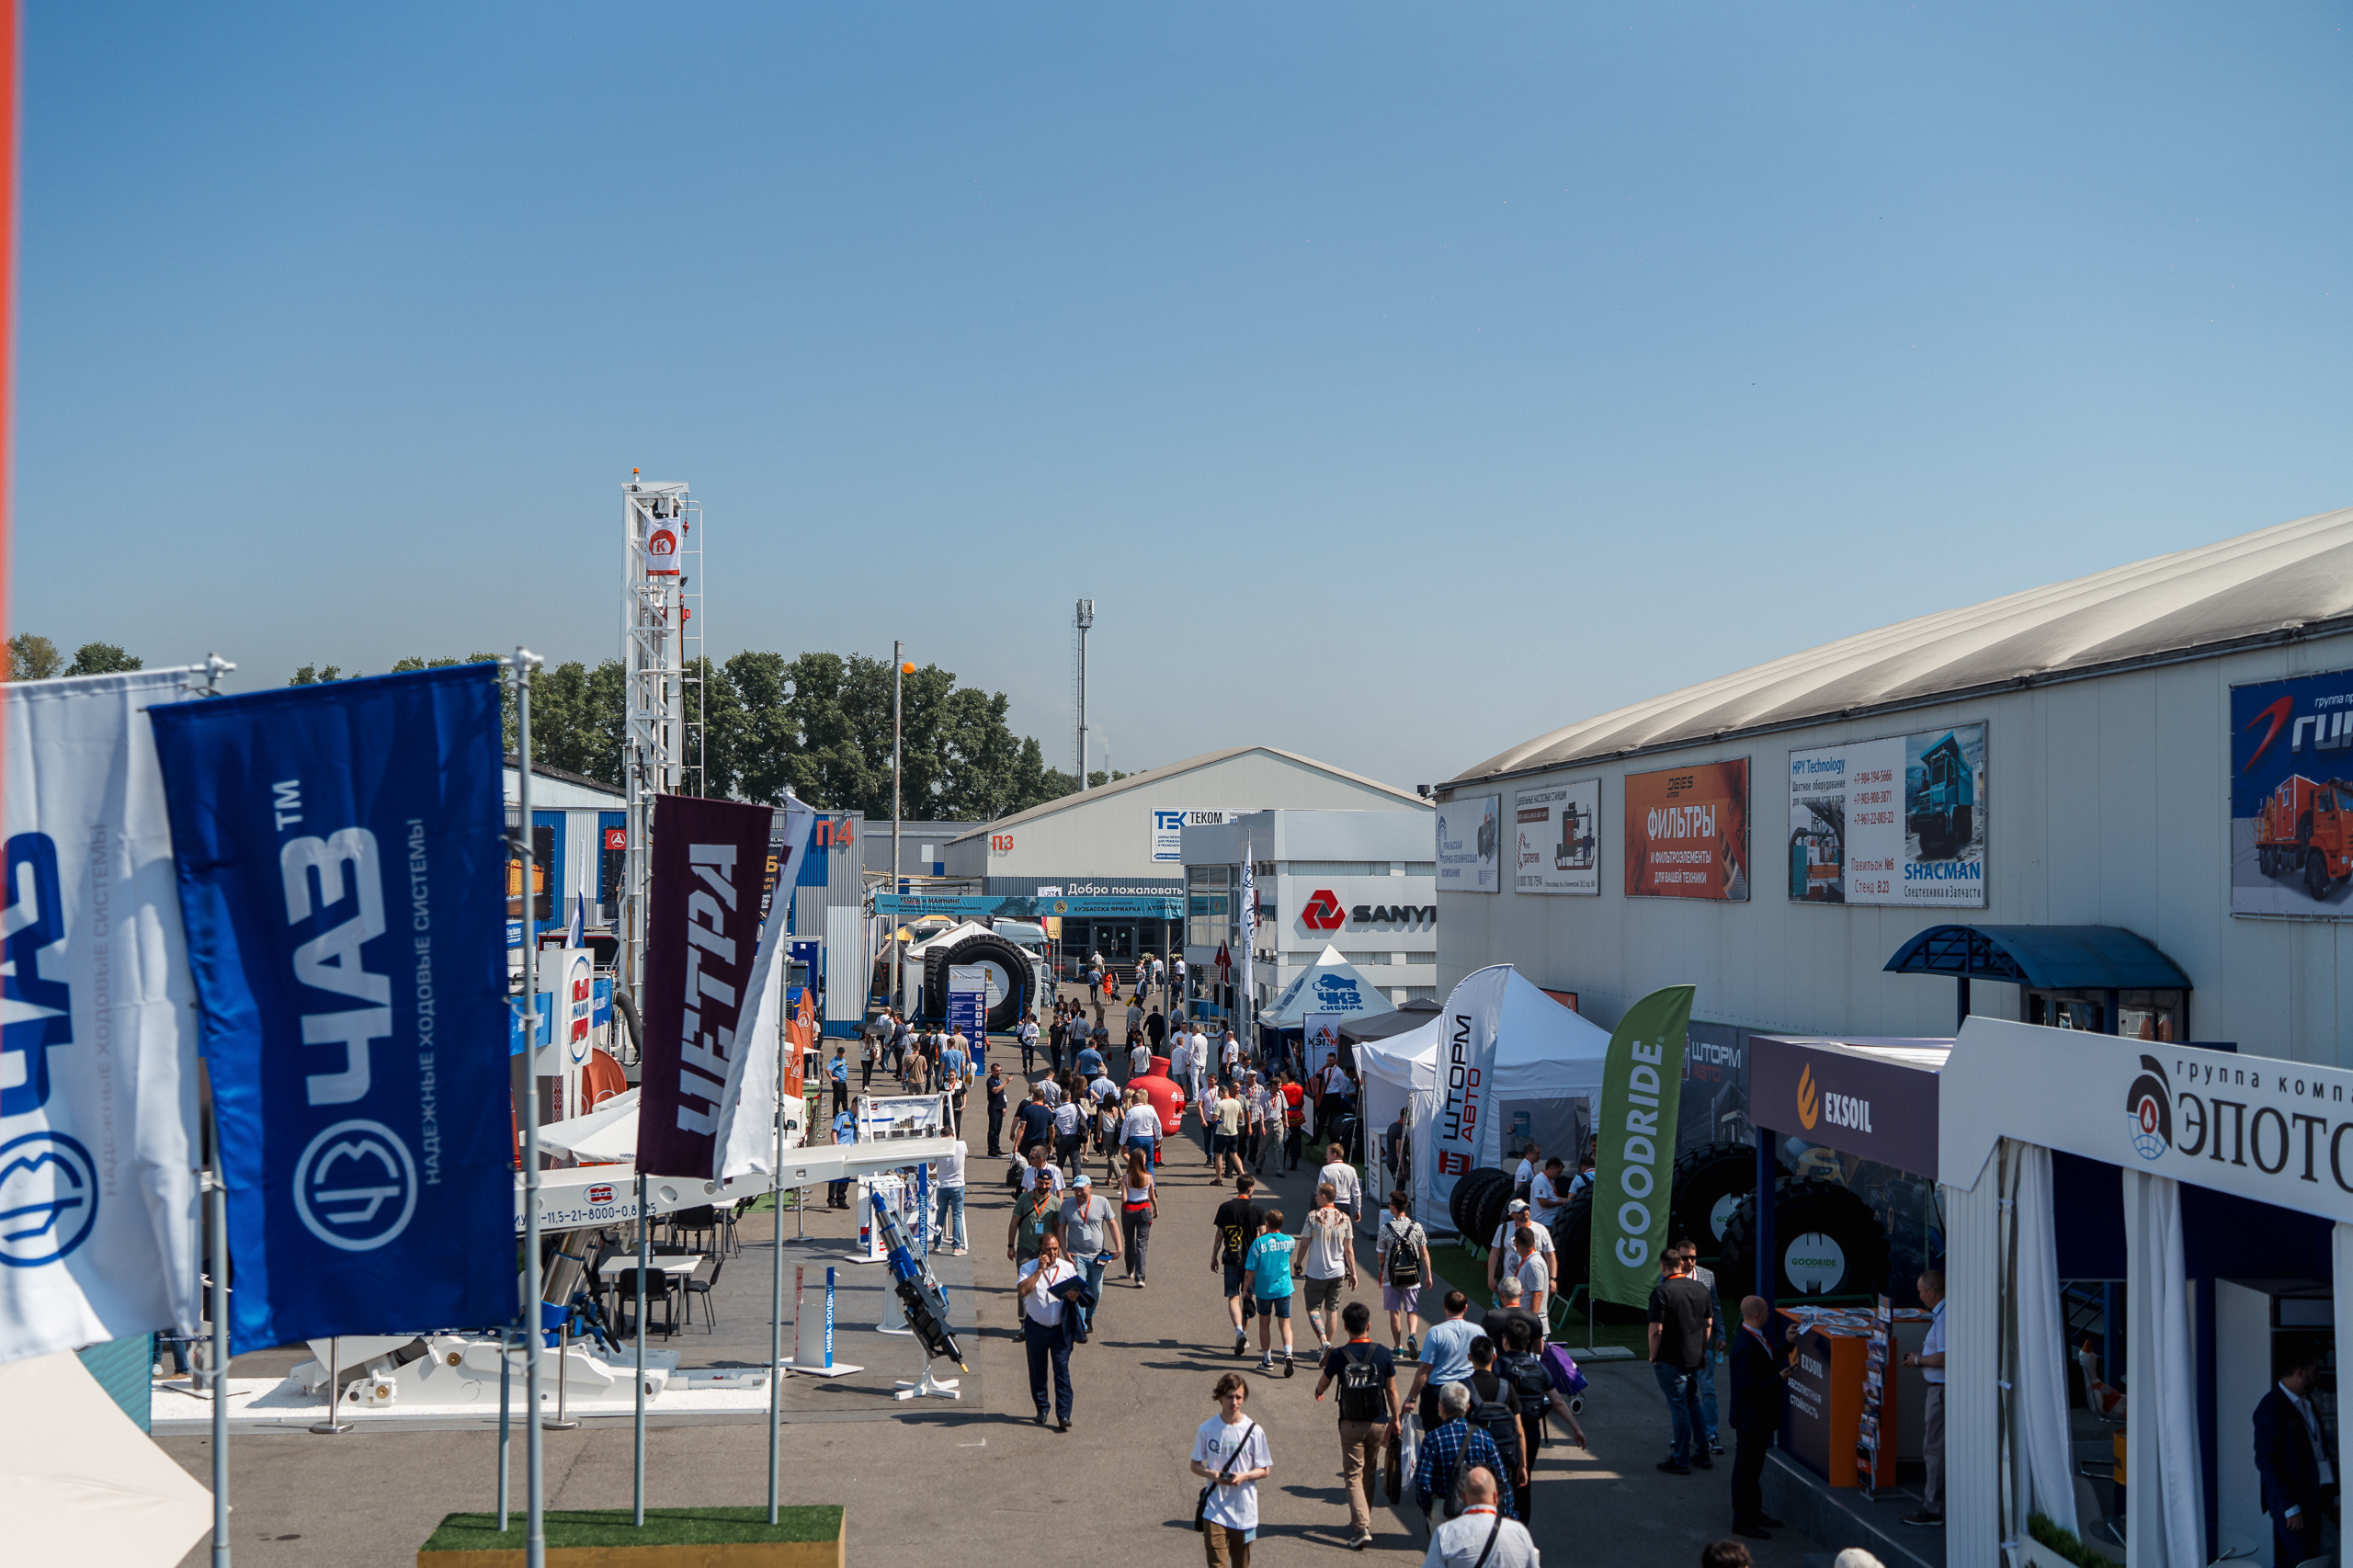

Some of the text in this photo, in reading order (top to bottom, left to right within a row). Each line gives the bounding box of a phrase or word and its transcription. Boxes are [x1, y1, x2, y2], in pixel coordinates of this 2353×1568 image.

[2314, 695, 2343, 709] группа
[1792, 756, 1846, 775] HPY Technology
[1813, 779, 1846, 792] оборудование
[1189, 812, 1222, 824] ТЕКОМ
[1647, 804, 1716, 841] ФИЛЬТРЫ
[1655, 850, 1711, 864] ФИЛЬТРОЭЛЕМЕНТЫ
[1851, 858, 1883, 871] Павильон
[91, 824, 110, 939] СИСТЕМЫ
[1665, 869, 1681, 883] ВАШЕЙ
[1683, 872, 1707, 884] ТЕХНИКИ
[1904, 862, 1981, 881] SHACMAN
[927, 896, 961, 904] МАЙНИНГ
[1068, 883, 1108, 897] Добро
[1111, 886, 1183, 895] пожаловать
[1855, 880, 1875, 895] Стенд
[1904, 885, 1944, 900] Спецтехника
[1949, 884, 1981, 899] Запчасти
[279, 826, 392, 1106] ЧАЗ
[93, 941, 112, 1055] ХОДОВЫЕ
[406, 818, 441, 1185] НАДЕЖНЫЕ ХОДОВЫЕ СИСТЕМЫ
[1317, 991, 1362, 1005] ЧКЗ
[1691, 1040, 1741, 1069] ШТОРМ
[1443, 1014, 1472, 1141] ШТОРМ
[2177, 1061, 2353, 1104] группа комп
[1461, 1067, 1482, 1144] АВТО
[1824, 1091, 1872, 1134] EXSOIL
[1615, 1040, 1664, 1268] GOODRIDE
[1791, 1258, 1837, 1267] GOODRIDE
[825, 1282, 834, 1353] НИВА-ХОЛДИНГ
[1801, 1353, 1823, 1380] EXSOIL
[1787, 1377, 1822, 1405] АБСОЛЮТНАЯ
[1790, 1393, 1819, 1420] СТОЙКОСТЬ
